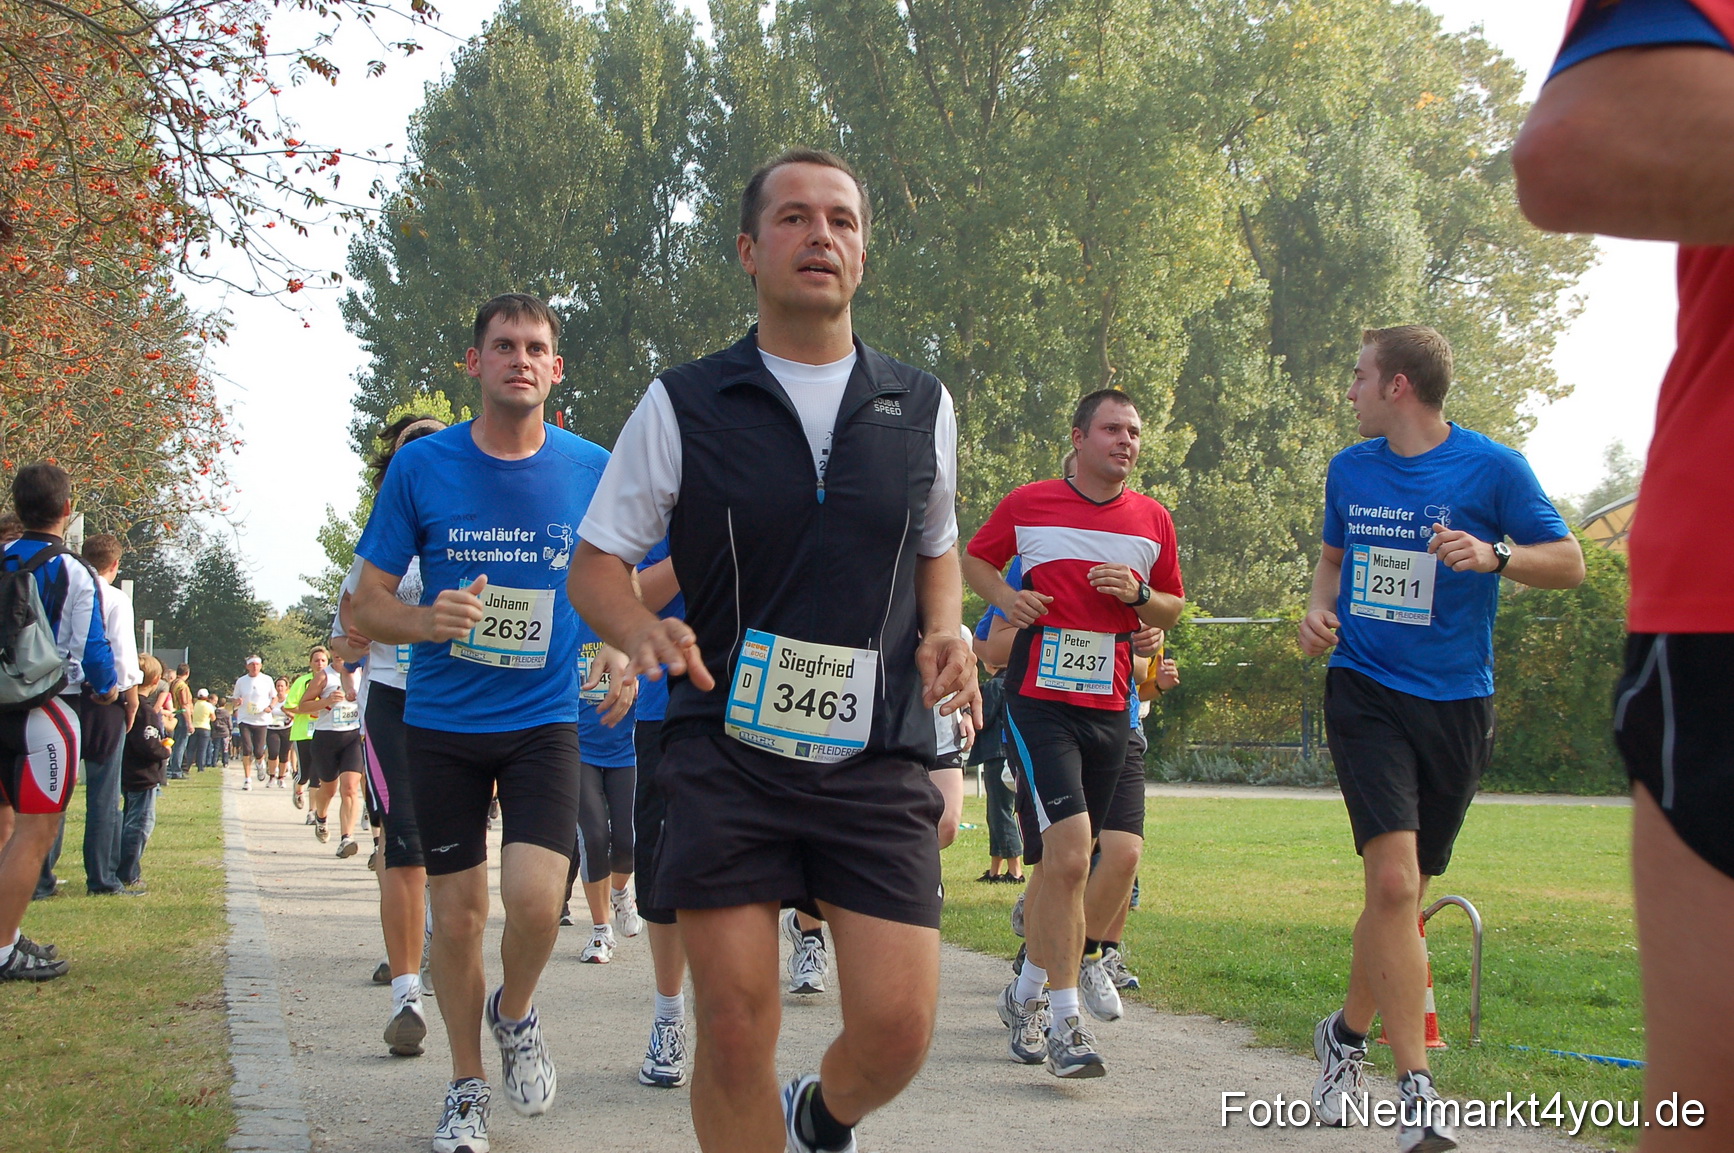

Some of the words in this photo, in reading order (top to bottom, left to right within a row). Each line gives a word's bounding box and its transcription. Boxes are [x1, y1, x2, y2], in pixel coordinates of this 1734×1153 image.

[874, 404, 902, 416] SPEED
[1348, 504, 1415, 521] Kirwaläufer
[448, 527, 537, 542] Kirwaläufer
[447, 548, 538, 562] Pettenhofen
[1373, 553, 1411, 571] Michael
[1371, 575, 1421, 599] 2311
[485, 593, 530, 611] Johann
[482, 616, 542, 641] 2632
[1064, 633, 1091, 648] Peter
[1045, 648, 1051, 657] D
[778, 647, 855, 679] Siegfried
[1062, 652, 1108, 672] 2437
[742, 672, 752, 688] D
[773, 683, 858, 723] 3463
